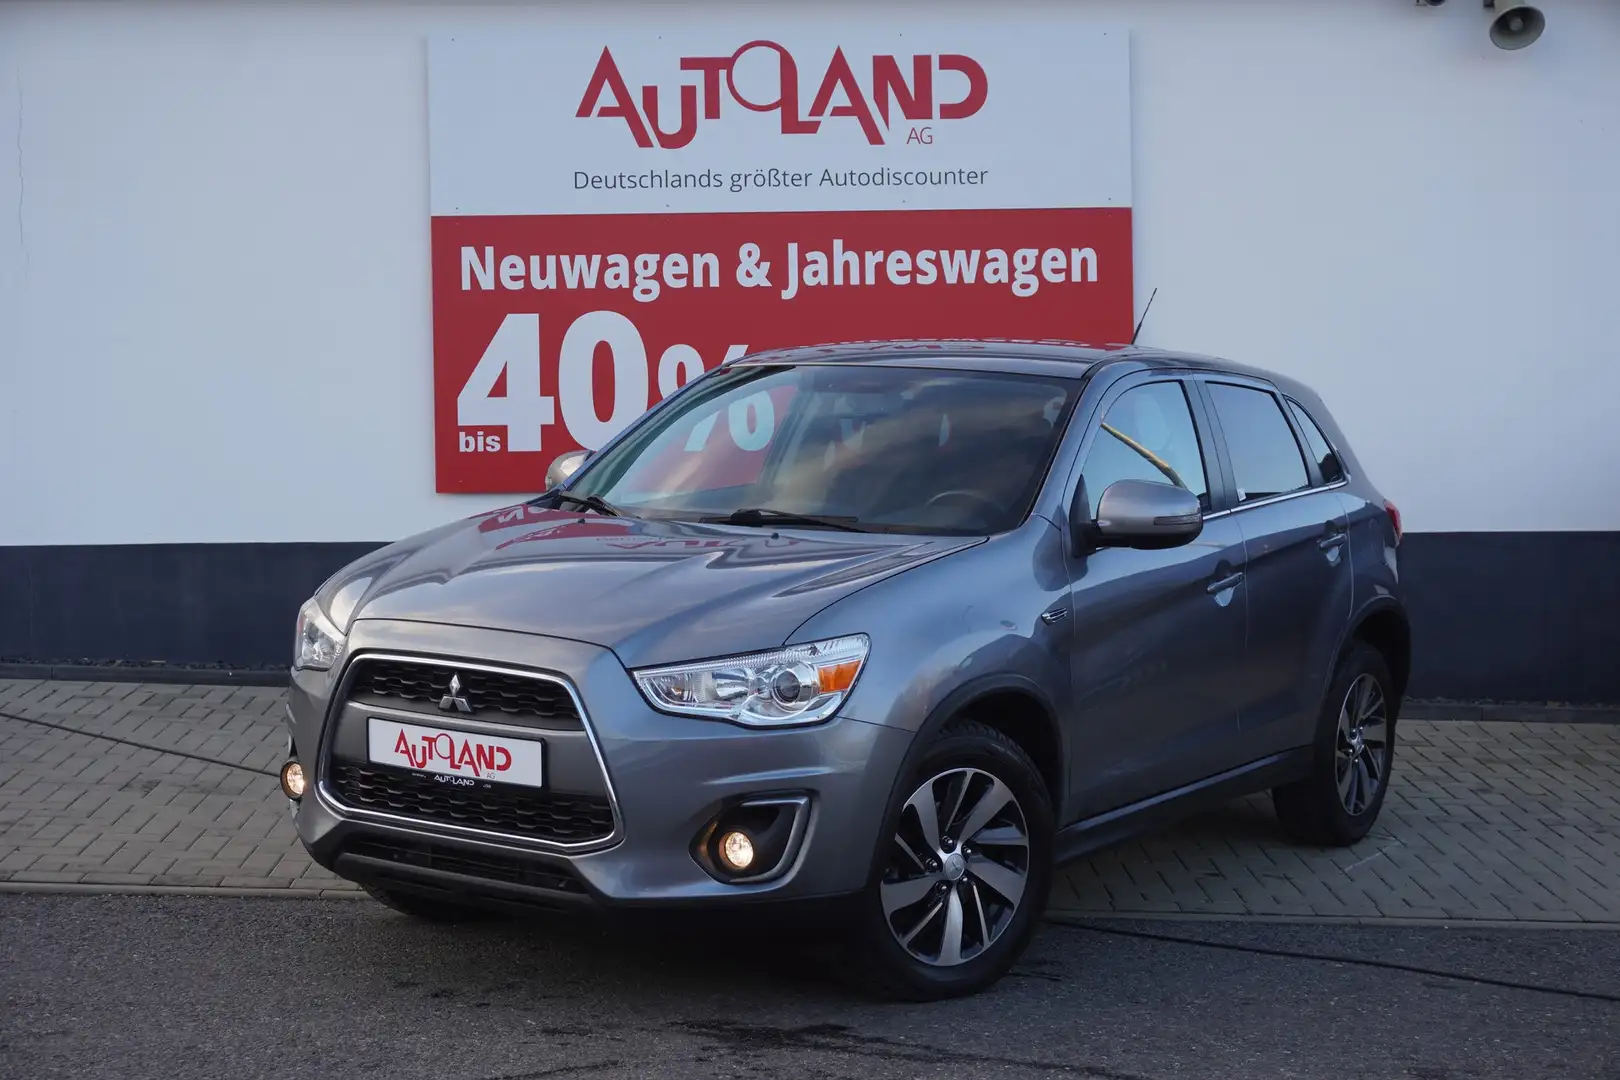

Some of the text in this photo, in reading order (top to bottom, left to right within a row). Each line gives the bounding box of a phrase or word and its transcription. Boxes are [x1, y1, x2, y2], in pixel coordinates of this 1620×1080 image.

[906, 127, 933, 145] AG
[574, 166, 988, 193] Deutschlands größter Autodiscounter
[461, 238, 1098, 302] Neuwagen & Jahreswagen
[459, 431, 501, 452] bis
